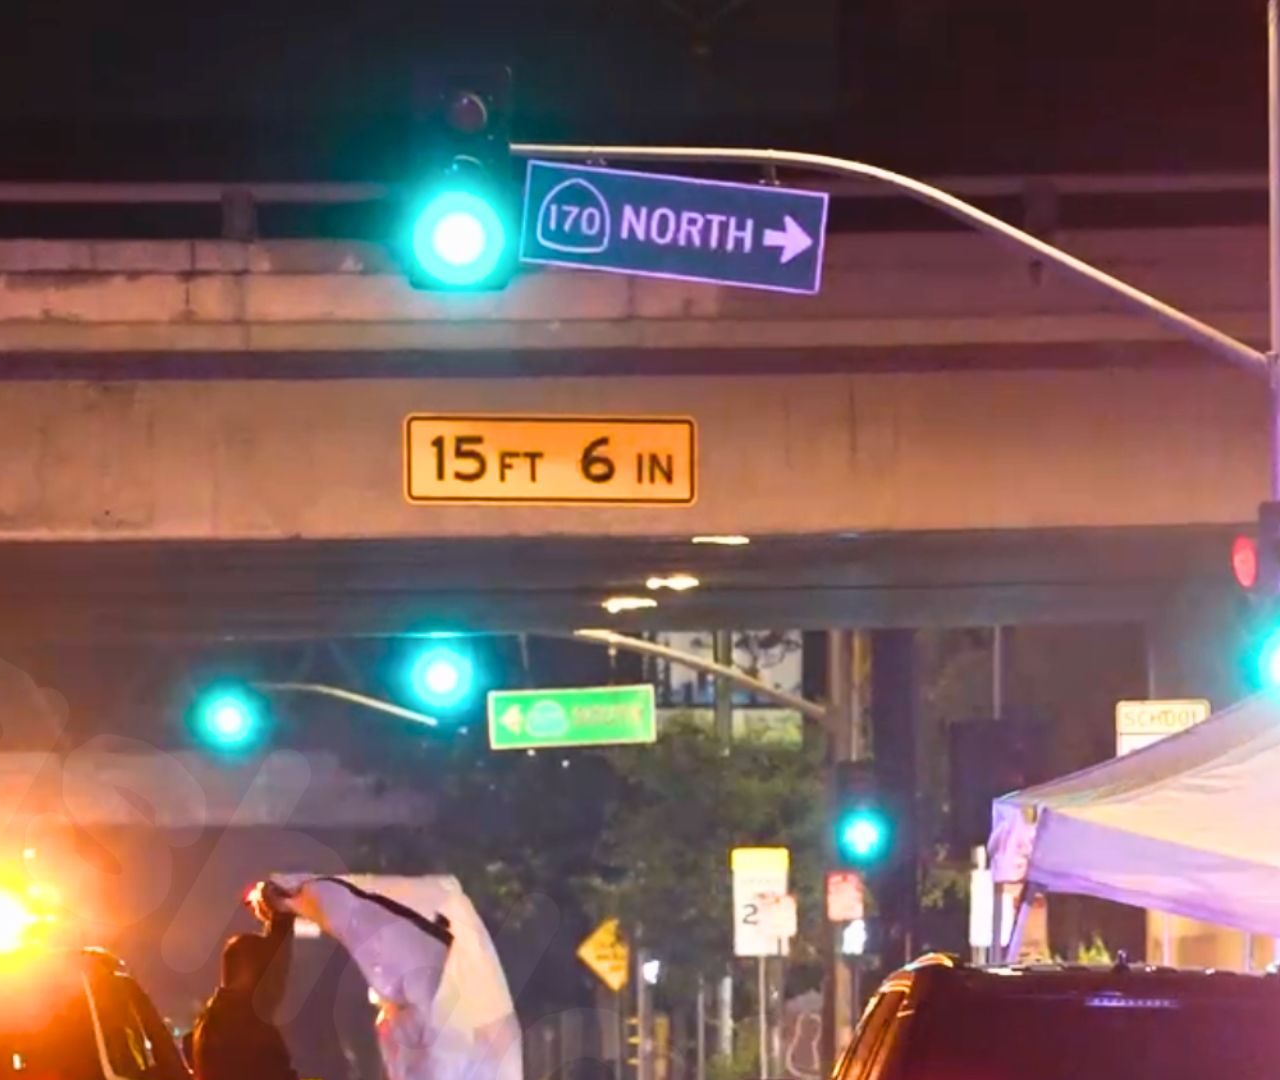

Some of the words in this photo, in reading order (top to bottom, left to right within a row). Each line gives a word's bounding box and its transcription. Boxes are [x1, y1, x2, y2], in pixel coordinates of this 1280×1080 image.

[548, 204, 602, 237] 170
[621, 205, 754, 253] NORTH
[431, 435, 487, 482] 15
[499, 452, 544, 482] FT
[581, 437, 615, 482] 6
[637, 454, 673, 484] IN
[742, 903, 759, 925] 2
